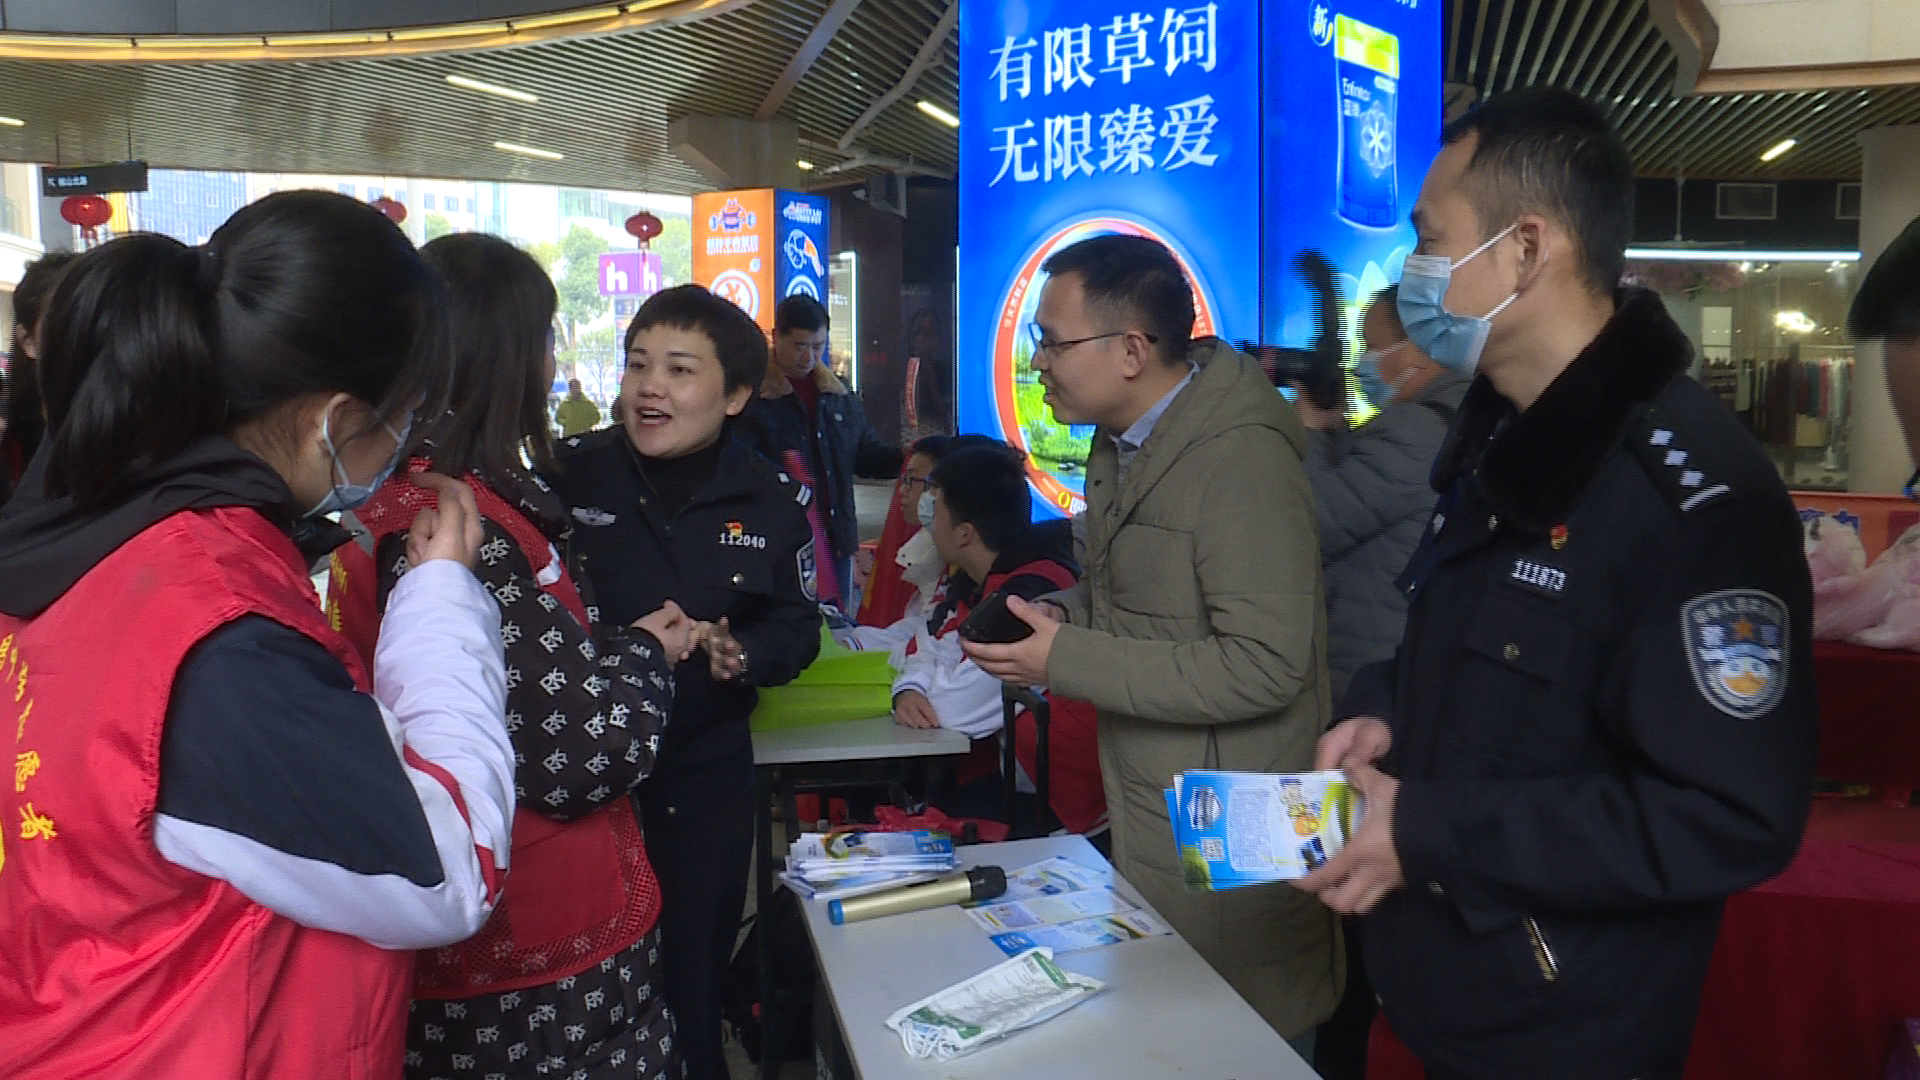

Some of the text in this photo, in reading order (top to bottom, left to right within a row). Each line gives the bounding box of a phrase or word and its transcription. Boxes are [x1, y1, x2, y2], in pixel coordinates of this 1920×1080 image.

[989, 2, 1218, 102] 有限草饲
[989, 94, 1220, 188] 无限臻爱
[719, 532, 766, 550] 112040
[1511, 559, 1567, 591] 111873
